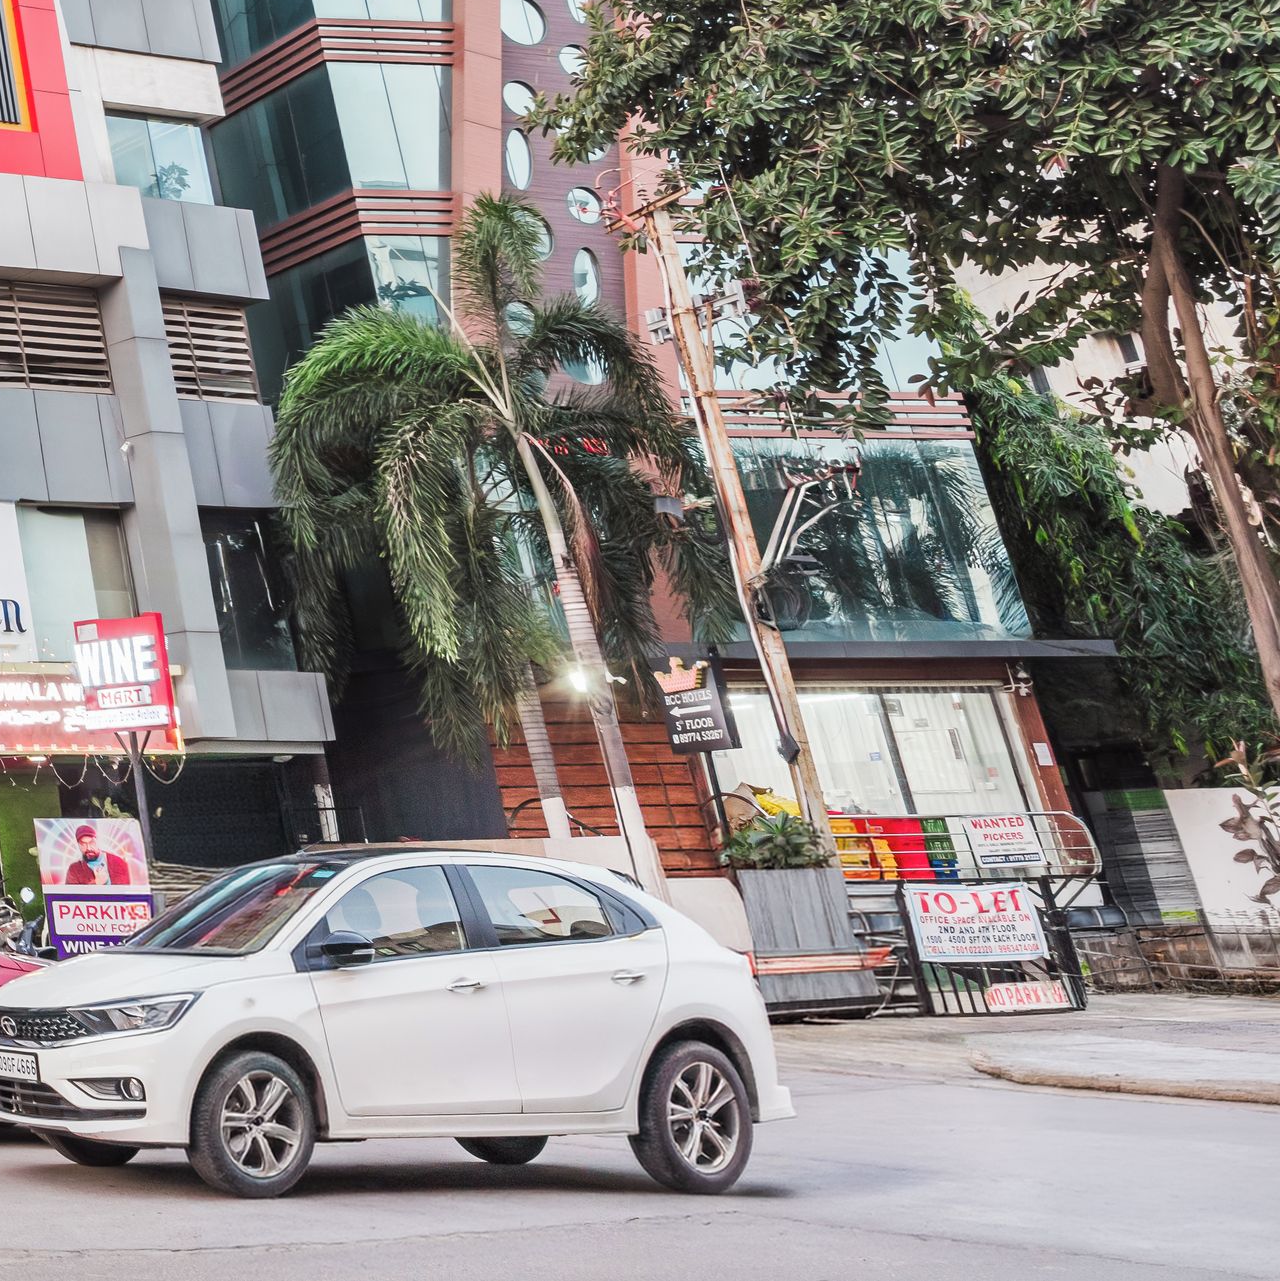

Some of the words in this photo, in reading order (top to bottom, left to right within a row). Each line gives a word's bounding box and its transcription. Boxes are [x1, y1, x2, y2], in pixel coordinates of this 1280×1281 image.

[73, 634, 160, 688] WINE
[101, 688, 144, 706] MART
[664, 695, 681, 706] RCC
[681, 690, 713, 703] HOTELS
[685, 717, 715, 730] FLOOR
[971, 817, 1025, 829] WANTED
[983, 832, 1024, 841] PICKERS
[914, 889, 1021, 915] TO-LET
[920, 916, 950, 925] OFFICE
[952, 916, 976, 925] SPACE
[1019, 913, 1031, 922] ON
[76, 923, 107, 933] ONLY
[938, 925, 956, 934] 2ND
[959, 926, 976, 934] AND
[992, 923, 1018, 933] FLOOR
[926, 935, 943, 944] 1500
[948, 935, 967, 944] 4500
[969, 935, 981, 944] SFT
[982, 935, 992, 943] ON
[993, 934, 1011, 943] EACH
[1013, 933, 1038, 942] FLOOR
